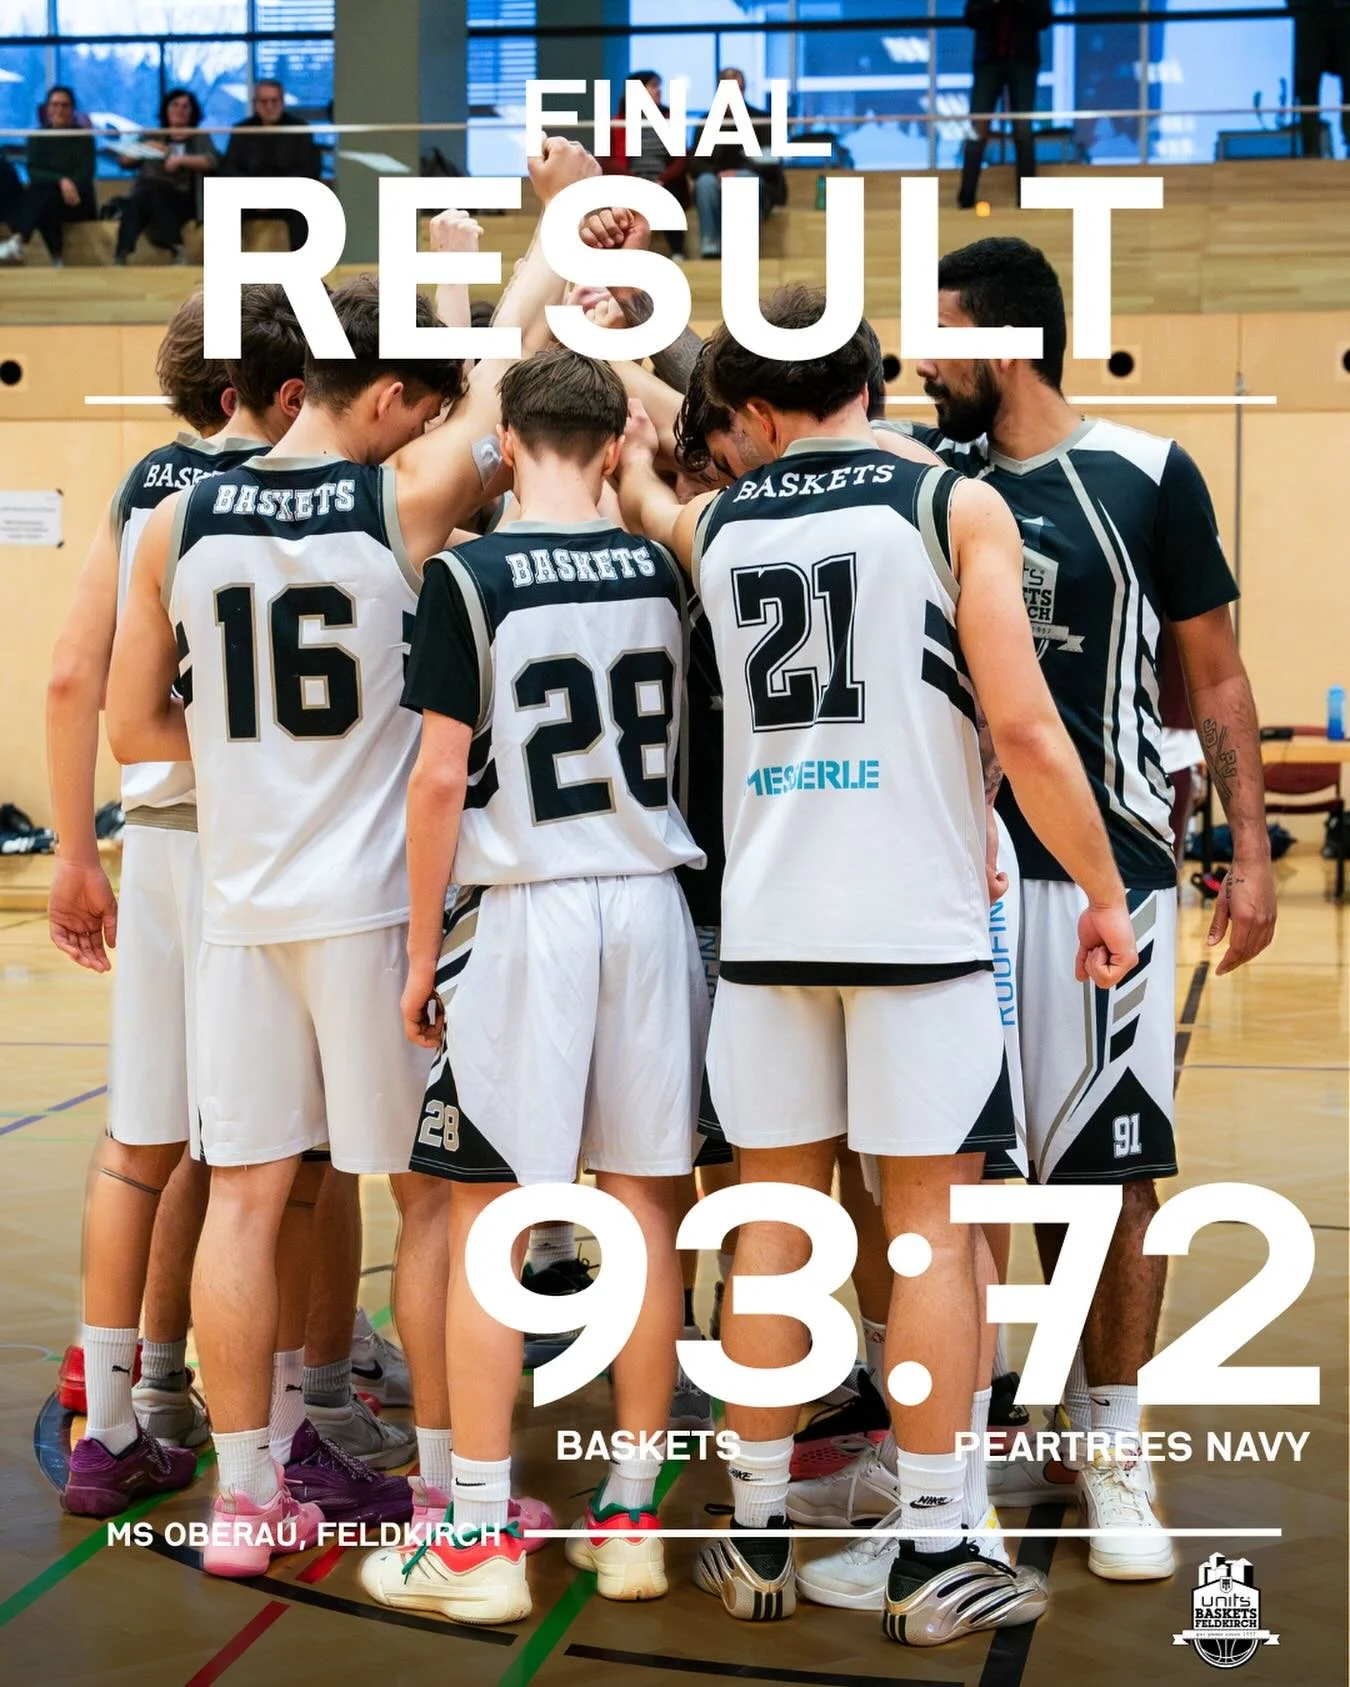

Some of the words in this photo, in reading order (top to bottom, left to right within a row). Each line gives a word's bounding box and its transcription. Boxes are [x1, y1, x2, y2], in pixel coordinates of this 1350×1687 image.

[143, 463, 226, 489] BASK
[733, 464, 896, 503] BASKETS
[213, 480, 355, 522] BASKETS
[505, 546, 656, 588] BASKETS
[213, 582, 363, 742] 16
[731, 552, 865, 733] 21
[511, 646, 677, 827] 28
[418, 1099, 459, 1152] 28
[1112, 1112, 1142, 1159] 91
